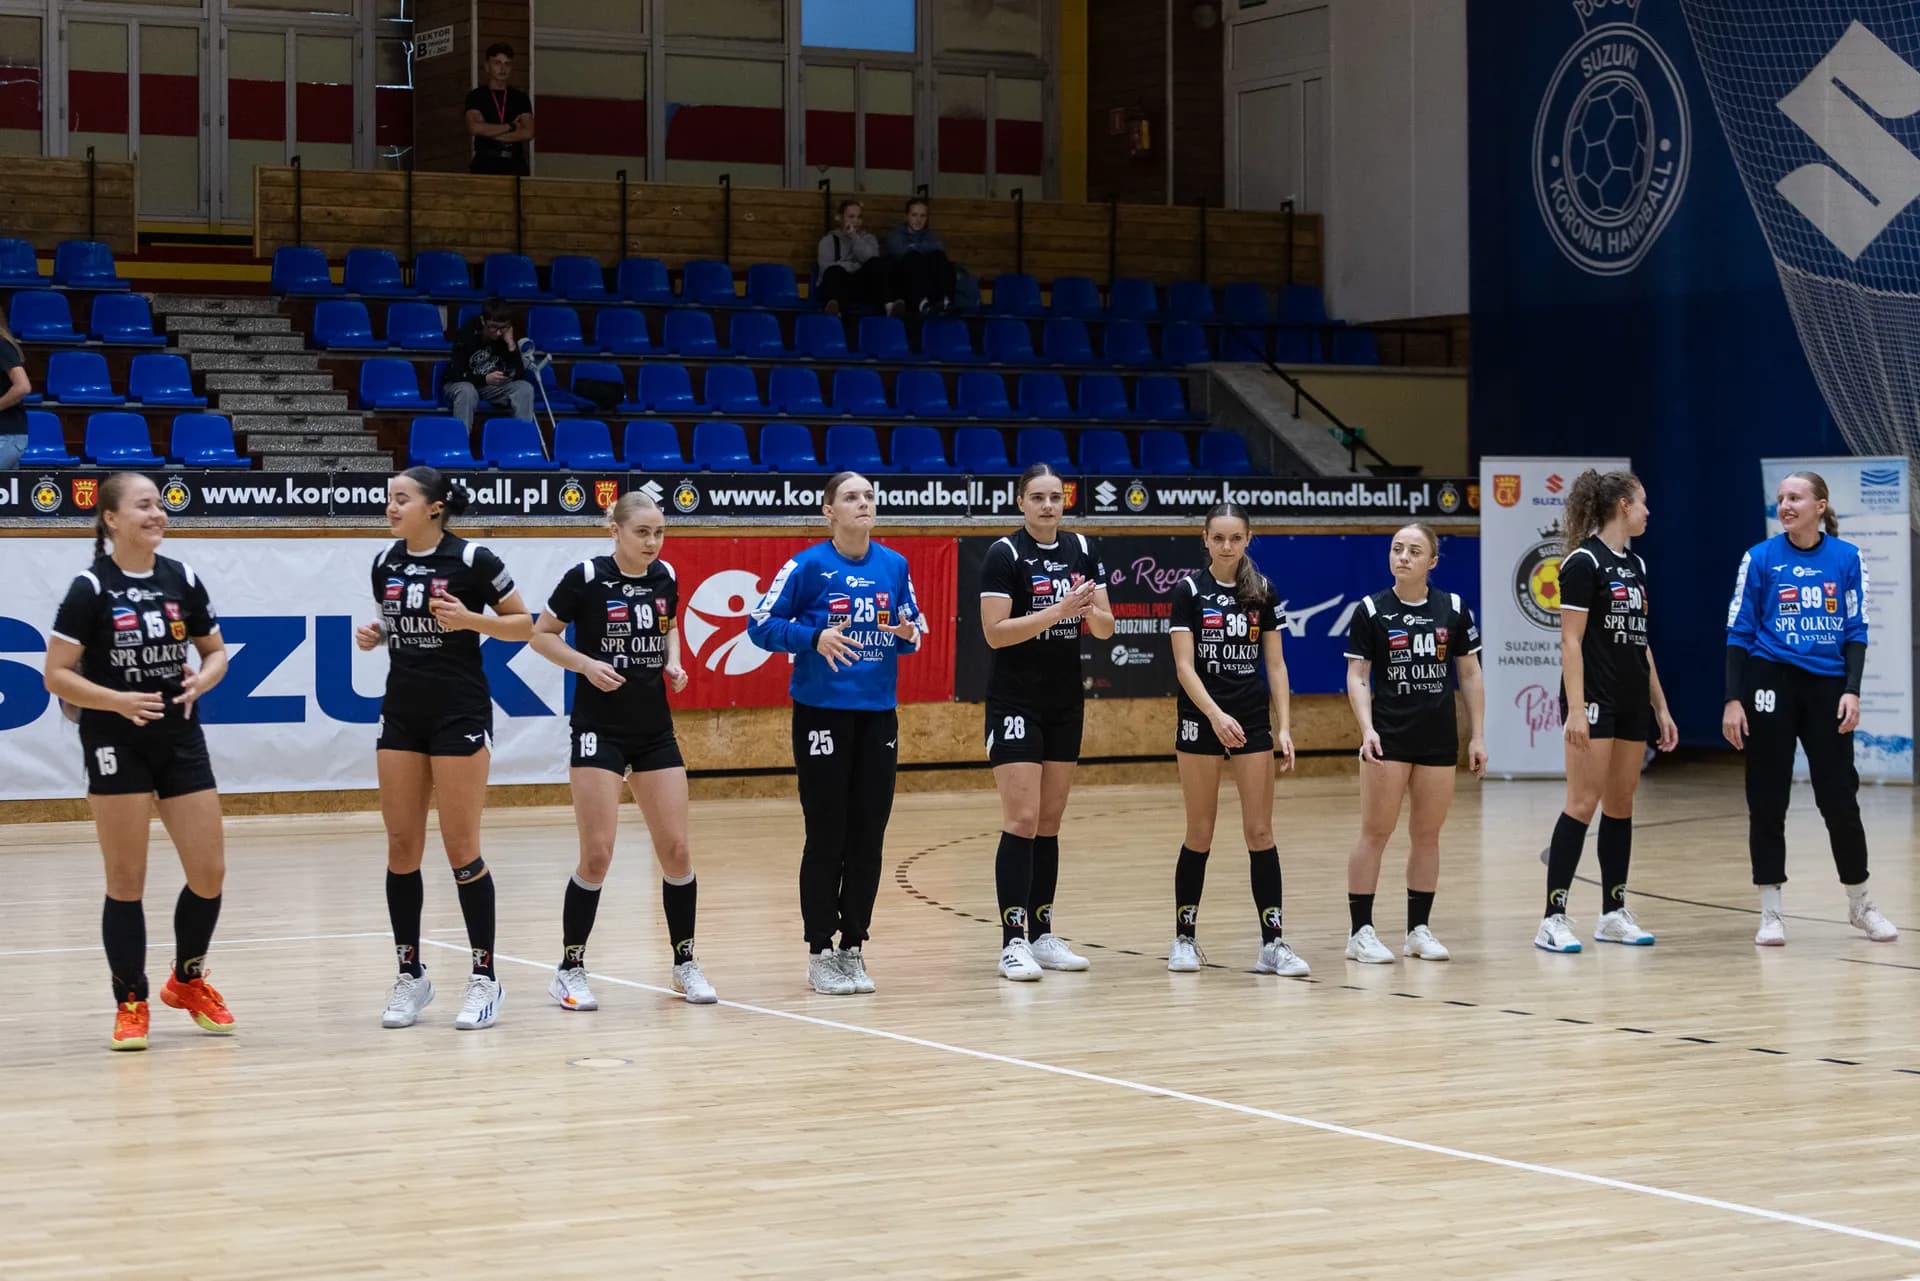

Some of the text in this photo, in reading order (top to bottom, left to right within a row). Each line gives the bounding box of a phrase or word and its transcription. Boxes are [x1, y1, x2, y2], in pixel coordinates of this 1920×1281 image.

[417, 43, 427, 57] B
[1580, 43, 1639, 79] SUZUKI
[1549, 161, 1674, 254] KORONA HANDBALL
[75, 491, 93, 506] CK
[709, 481, 1014, 513] www.korhandball.pl
[1156, 482, 1429, 514] www.koronahandball.pl
[1532, 498, 1568, 506] SUZU
[406, 583, 425, 609] 16
[1627, 587, 1642, 610] 50
[1801, 586, 1823, 609] 99
[634, 604, 654, 629] 19
[853, 597, 875, 622] 25
[143, 611, 166, 639] 15
[1114, 619, 1158, 634] GODZINIE
[1226, 613, 1247, 637] 36
[1604, 614, 1625, 630] SPR
[1775, 615, 1844, 632] SPR OLKUSZ
[600, 637, 625, 653] SPR
[1198, 643, 1218, 660] SPR
[1412, 633, 1437, 657] 44
[1505, 640, 1550, 651] SUZUKI
[110, 648, 137, 667] SPR
[1387, 665, 1407, 681] SPR
[1754, 689, 1776, 713] 99
[1003, 716, 1026, 739] 28
[580, 732, 598, 757] 19
[808, 730, 834, 756] 25
[95, 747, 118, 776] 15
